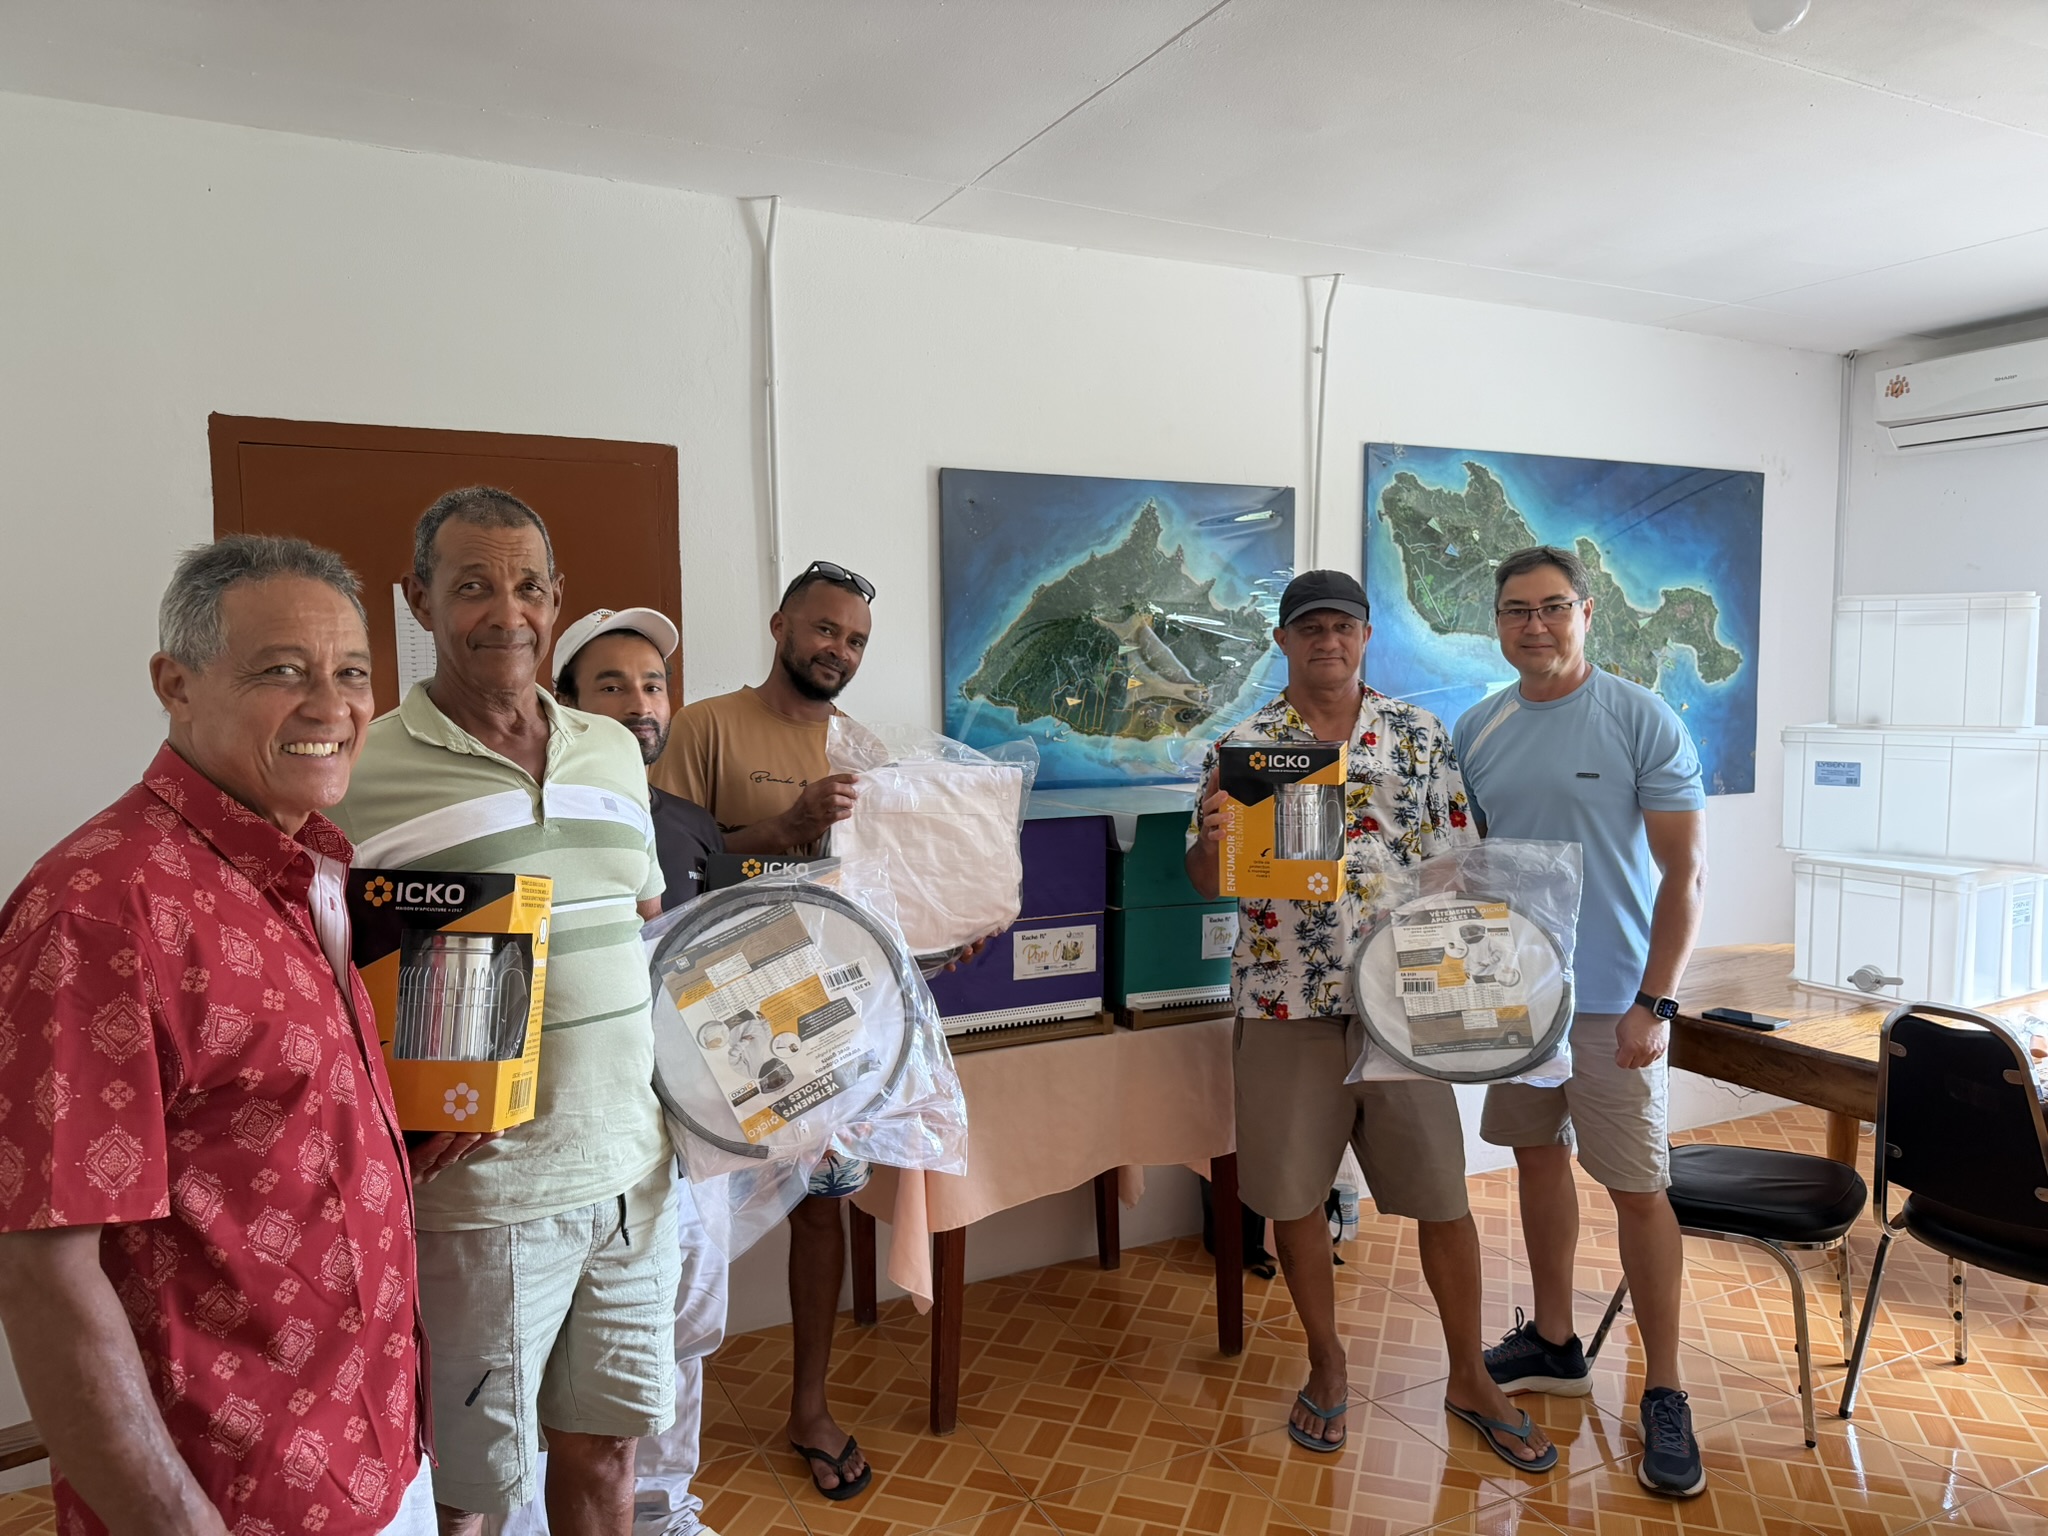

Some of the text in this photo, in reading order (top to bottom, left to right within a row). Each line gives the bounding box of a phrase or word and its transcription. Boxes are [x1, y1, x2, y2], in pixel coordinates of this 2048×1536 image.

[1268, 754, 1310, 768] ICKO
[1236, 804, 1244, 855] PREMIUM
[764, 862, 808, 875] ICKO
[1226, 834, 1236, 892] ENFUMOIR
[396, 882, 465, 905] ICKO
[1429, 908, 1476, 917] VÊTEMENTS
[1431, 914, 1468, 923] APICOLES
[731, 1086, 748, 1098] ICKO
[788, 1072, 833, 1102] APICOLES
[782, 1082, 839, 1118] VÊTEMENTS
[748, 1120, 772, 1138] ICKO
